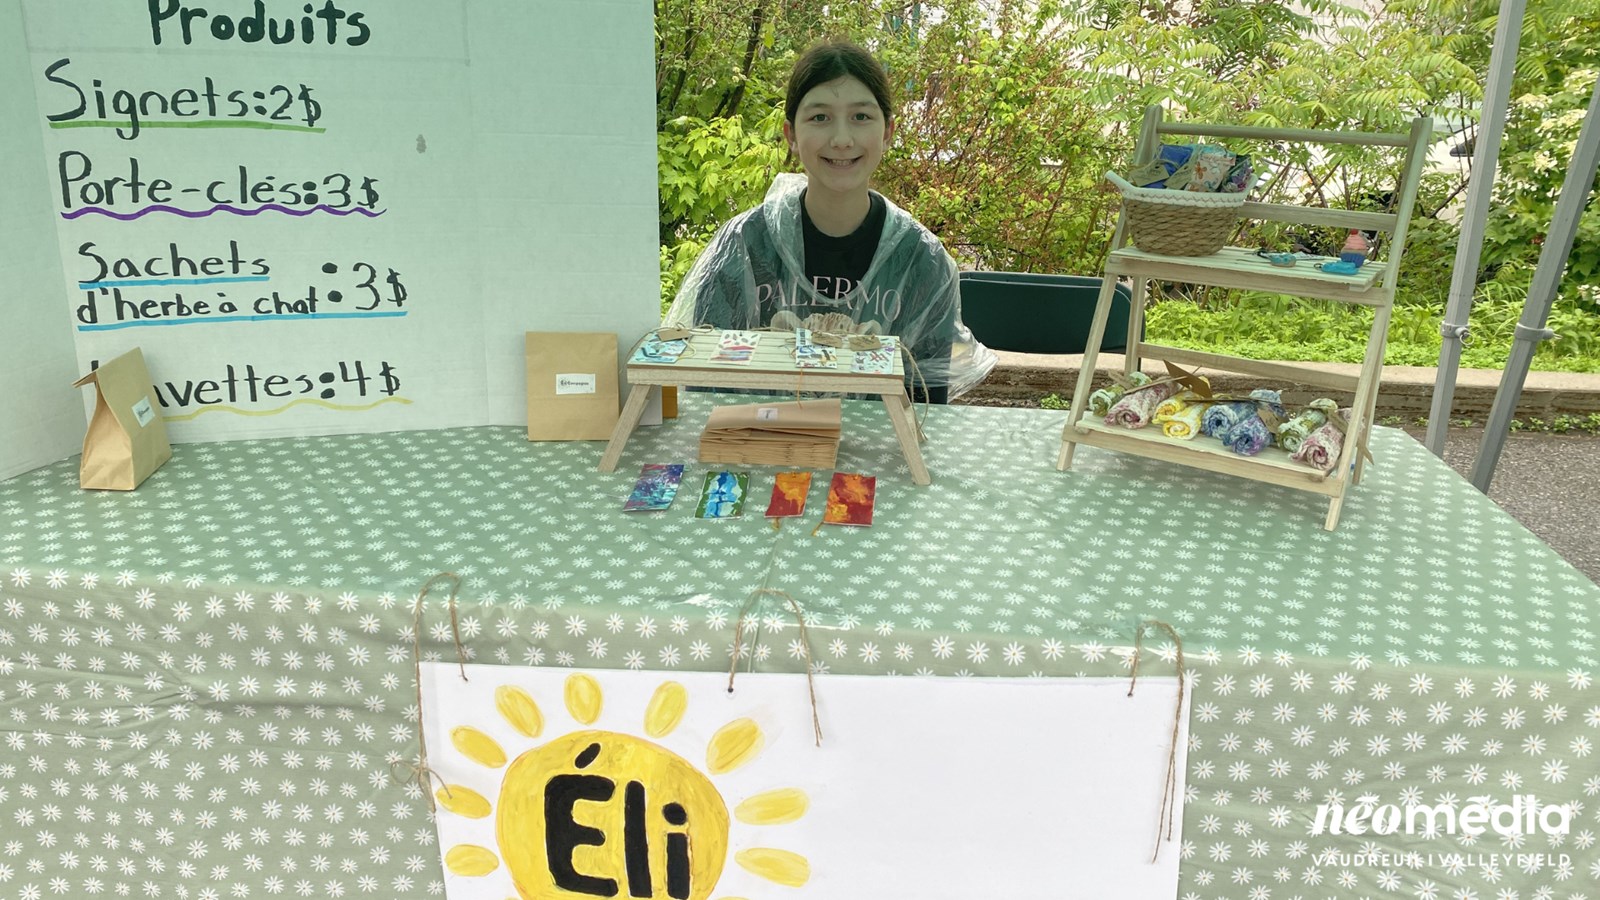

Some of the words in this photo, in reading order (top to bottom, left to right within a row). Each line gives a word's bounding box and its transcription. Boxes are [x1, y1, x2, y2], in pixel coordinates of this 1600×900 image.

[148, 0, 371, 46] Produits
[78, 241, 270, 284] Sachets
[77, 286, 210, 324] d'herbe
[217, 292, 238, 313] à
[253, 285, 319, 315] chat
[755, 276, 901, 322] PALERMO
[544, 742, 690, 900] Éli
